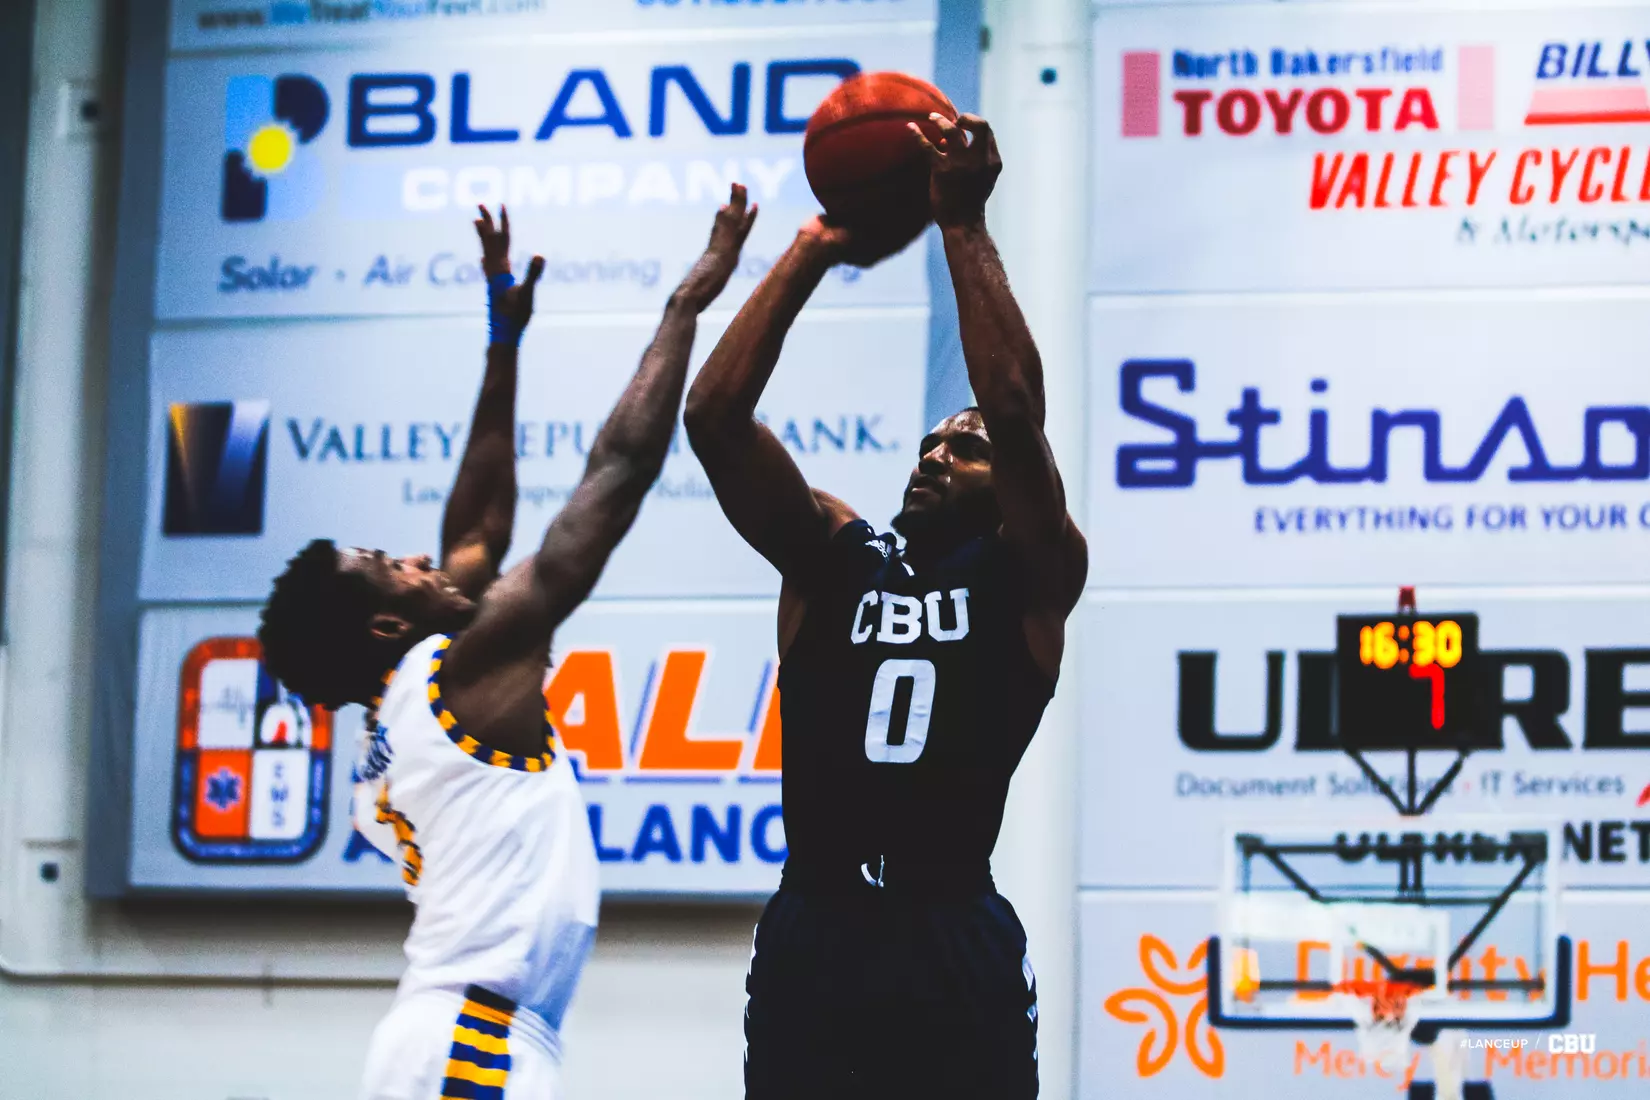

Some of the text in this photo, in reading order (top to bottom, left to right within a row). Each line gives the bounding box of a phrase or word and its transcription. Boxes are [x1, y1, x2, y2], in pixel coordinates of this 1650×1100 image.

[1172, 49, 1259, 79] North
[1172, 88, 1440, 137] TOYOTA
[401, 157, 797, 211] COMPANY
[1309, 150, 1497, 210] VALLEY
[217, 254, 316, 295] Solar
[363, 252, 418, 288] Air
[285, 418, 461, 463] VALLEY
[1254, 505, 1454, 534] EVERYTHING
[1466, 504, 1528, 532] FOR
[1540, 502, 1628, 531] YOUR
[850, 588, 970, 645] CBU
[1360, 620, 1462, 670] 16:30
[864, 658, 936, 764] 0
[1408, 662, 1445, 730] 7
[1175, 771, 1318, 799] Document
[1512, 769, 1626, 798] Services
[1484, 1042, 1650, 1080] Memori
